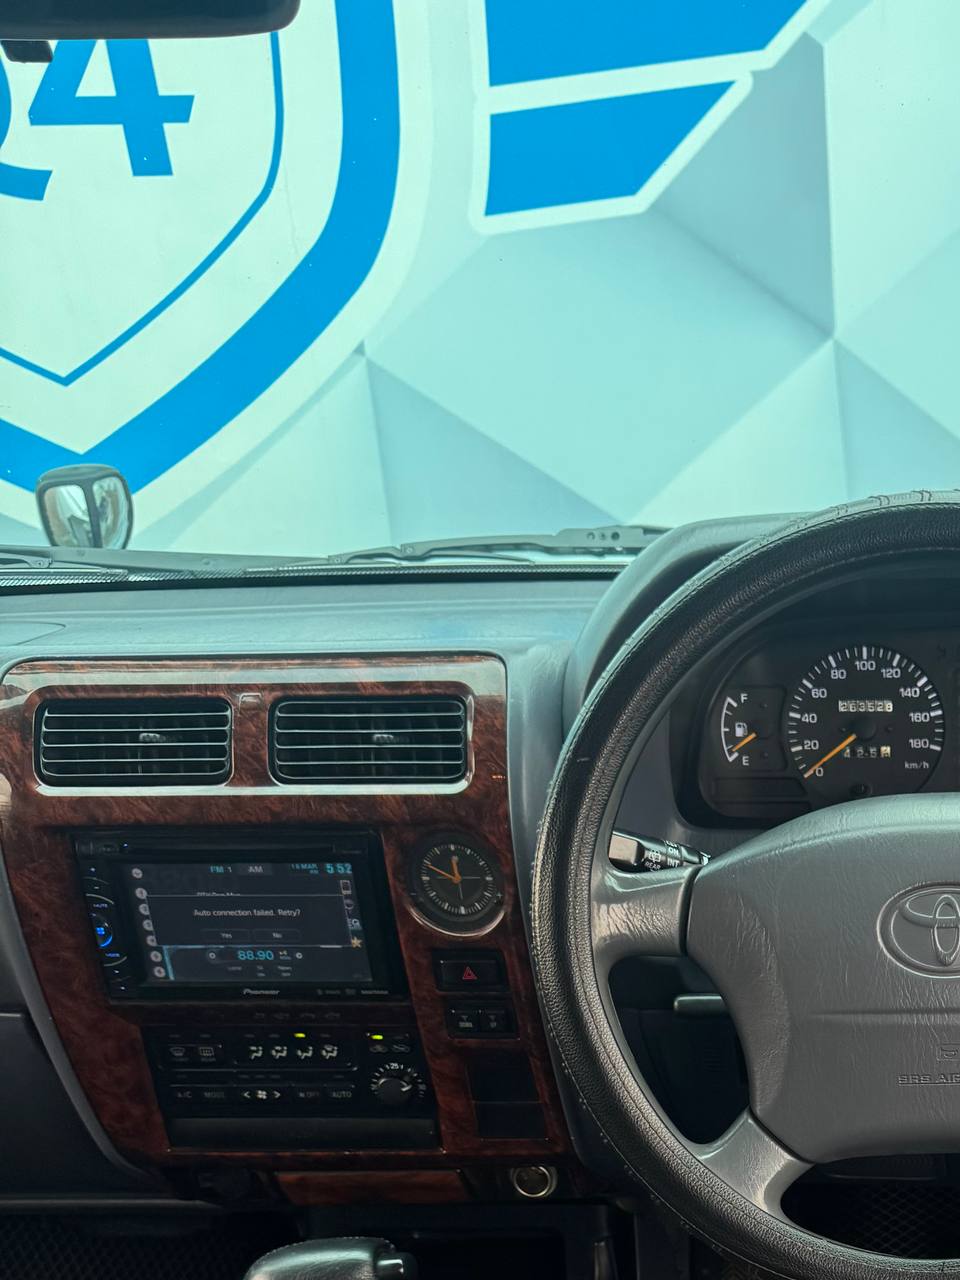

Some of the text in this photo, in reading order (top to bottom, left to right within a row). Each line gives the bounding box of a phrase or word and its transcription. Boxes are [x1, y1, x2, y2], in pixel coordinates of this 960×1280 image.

[855, 660, 876, 671] 100
[830, 669, 847, 680] 80
[880, 668, 901, 678] 120
[811, 688, 828, 698] 60
[899, 687, 920, 698] 140
[741, 693, 748, 703] F
[801, 713, 818, 724] 40
[908, 713, 930, 723] 160
[803, 740, 819, 750] 20
[908, 738, 930, 749] 180
[742, 756, 750, 765] E
[904, 760, 930, 769] km/h
[815, 767, 824, 777] 0
[193, 908, 211, 917] Auto
[212, 908, 252, 917] connection
[277, 908, 301, 918] Retry?
[238, 950, 275, 961] 88.90
[898, 1074, 931, 1084] SRS
